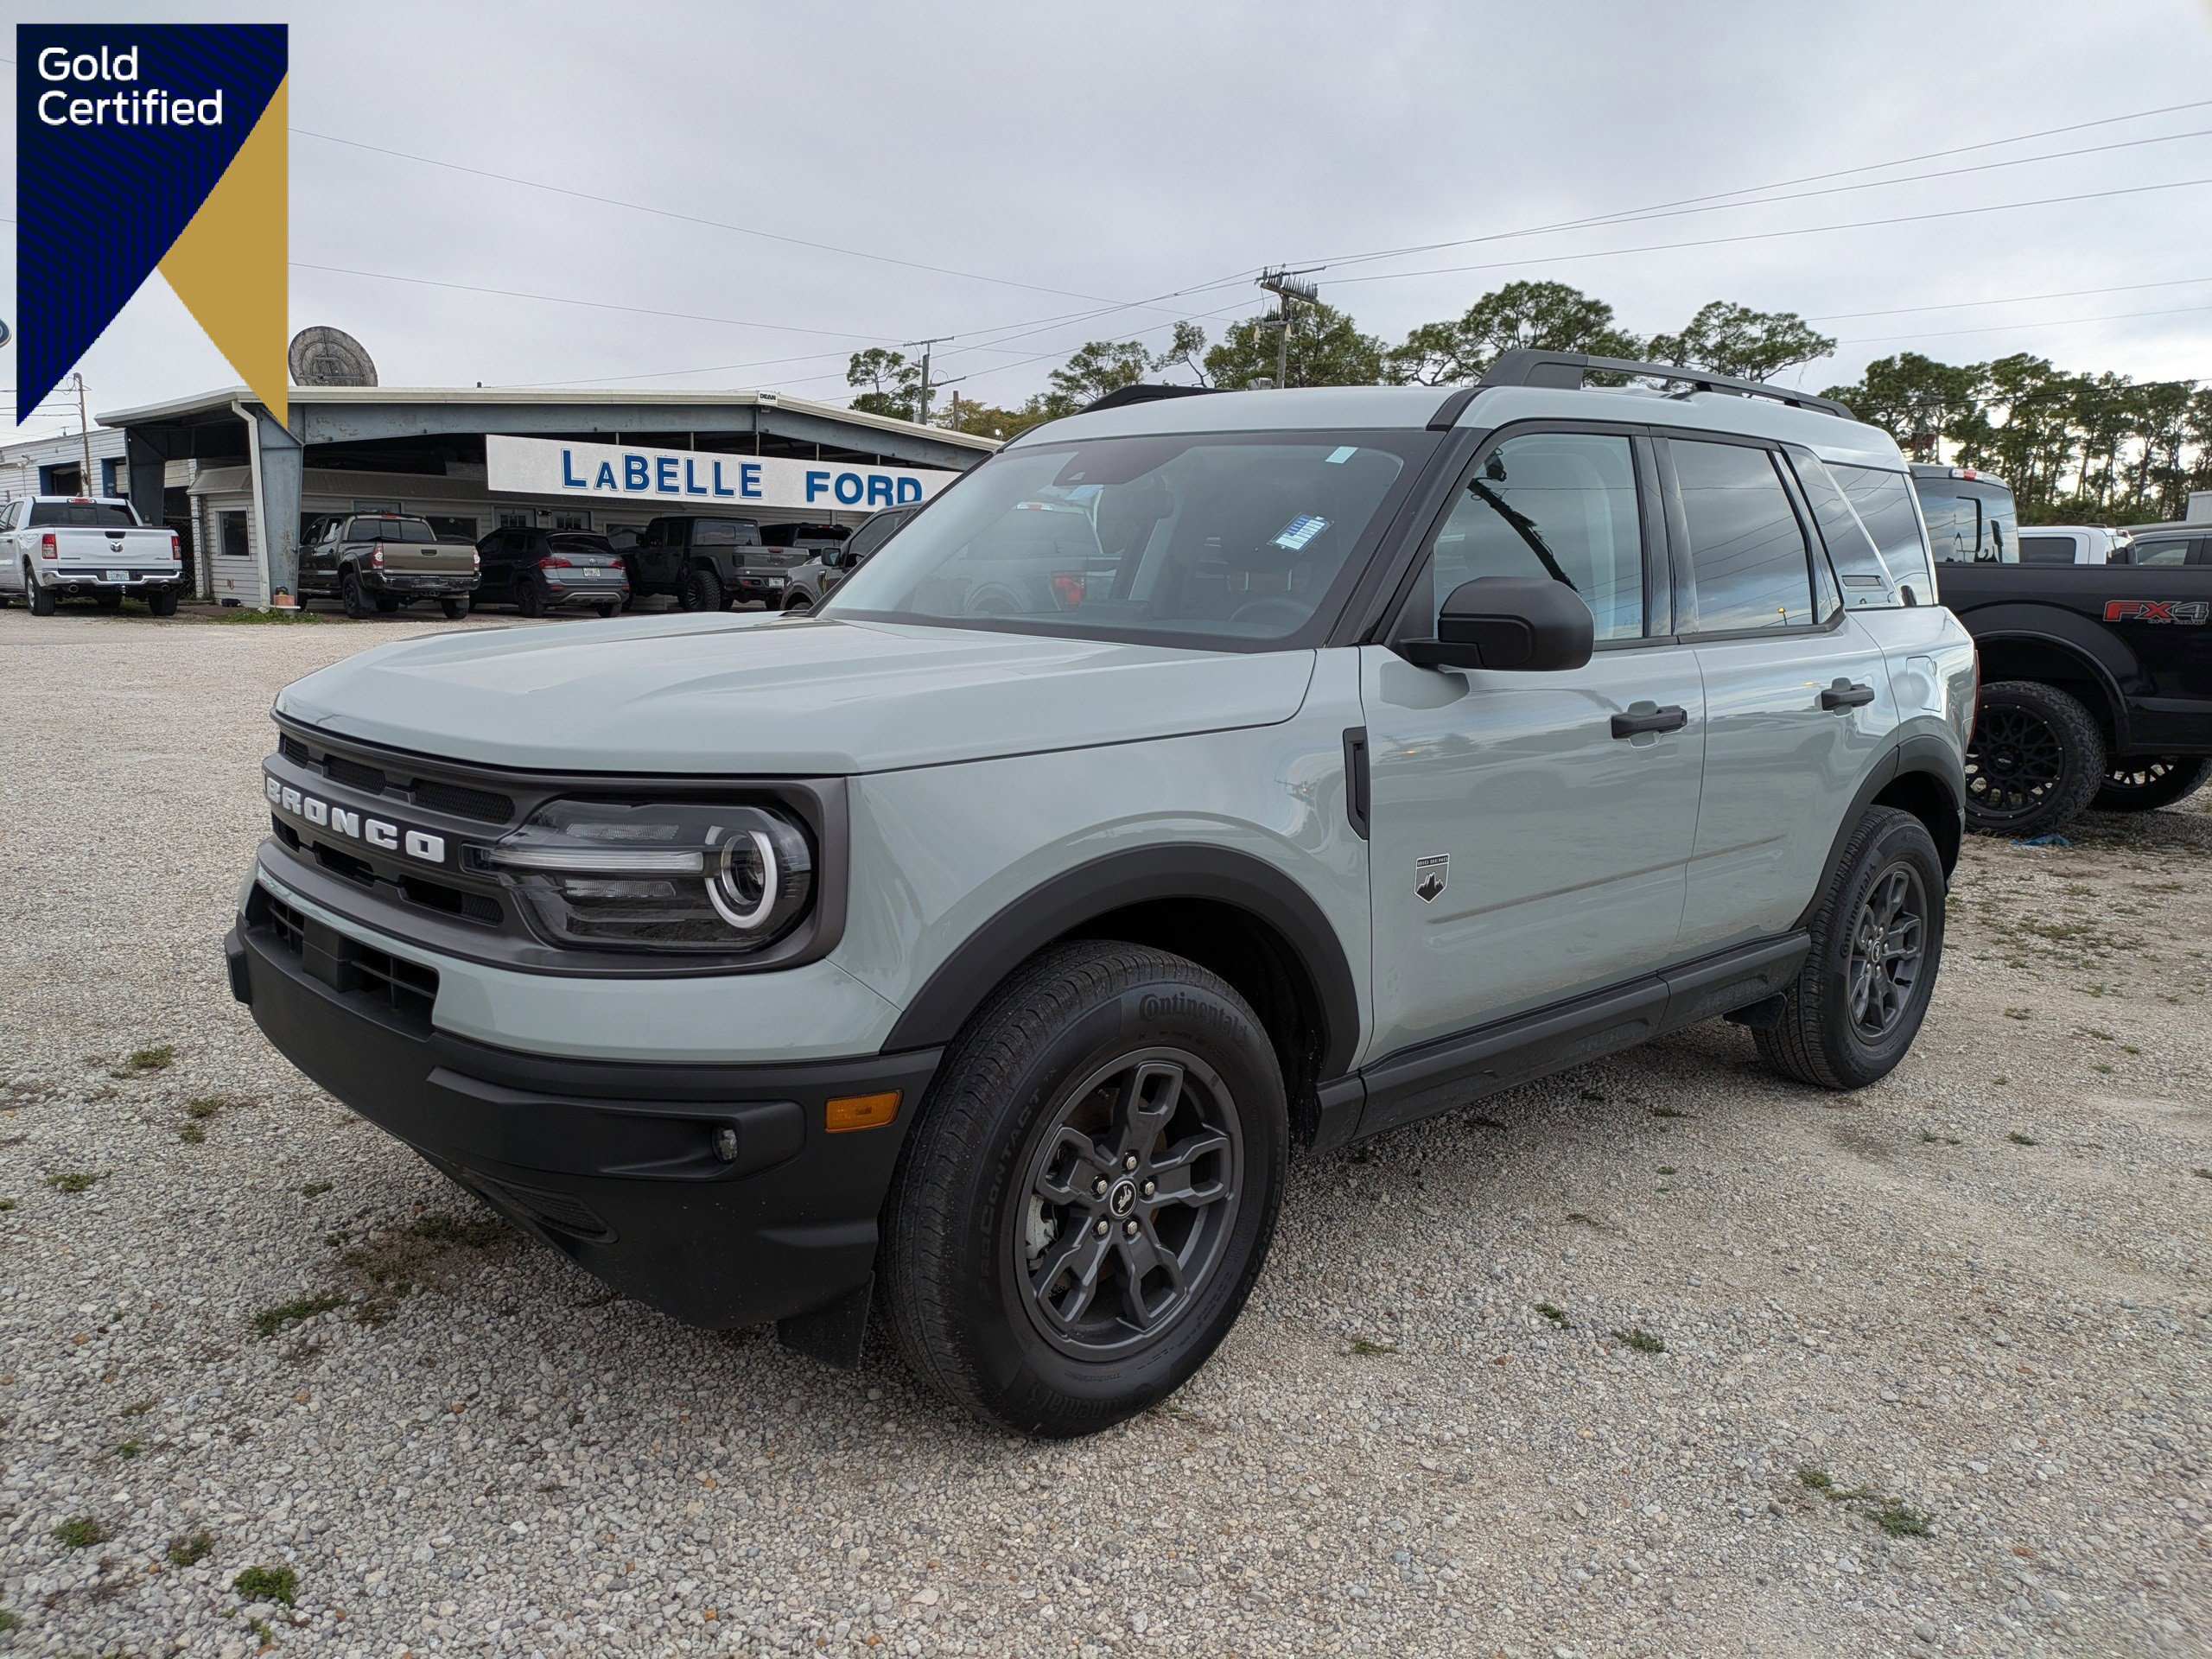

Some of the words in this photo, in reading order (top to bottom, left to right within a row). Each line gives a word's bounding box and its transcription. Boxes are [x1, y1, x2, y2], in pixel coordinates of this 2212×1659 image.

[805, 470, 923, 505] FORD
[2103, 599, 2209, 622] FX4
[265, 776, 446, 863] BRONCO
[1139, 991, 1238, 1035] Continental
